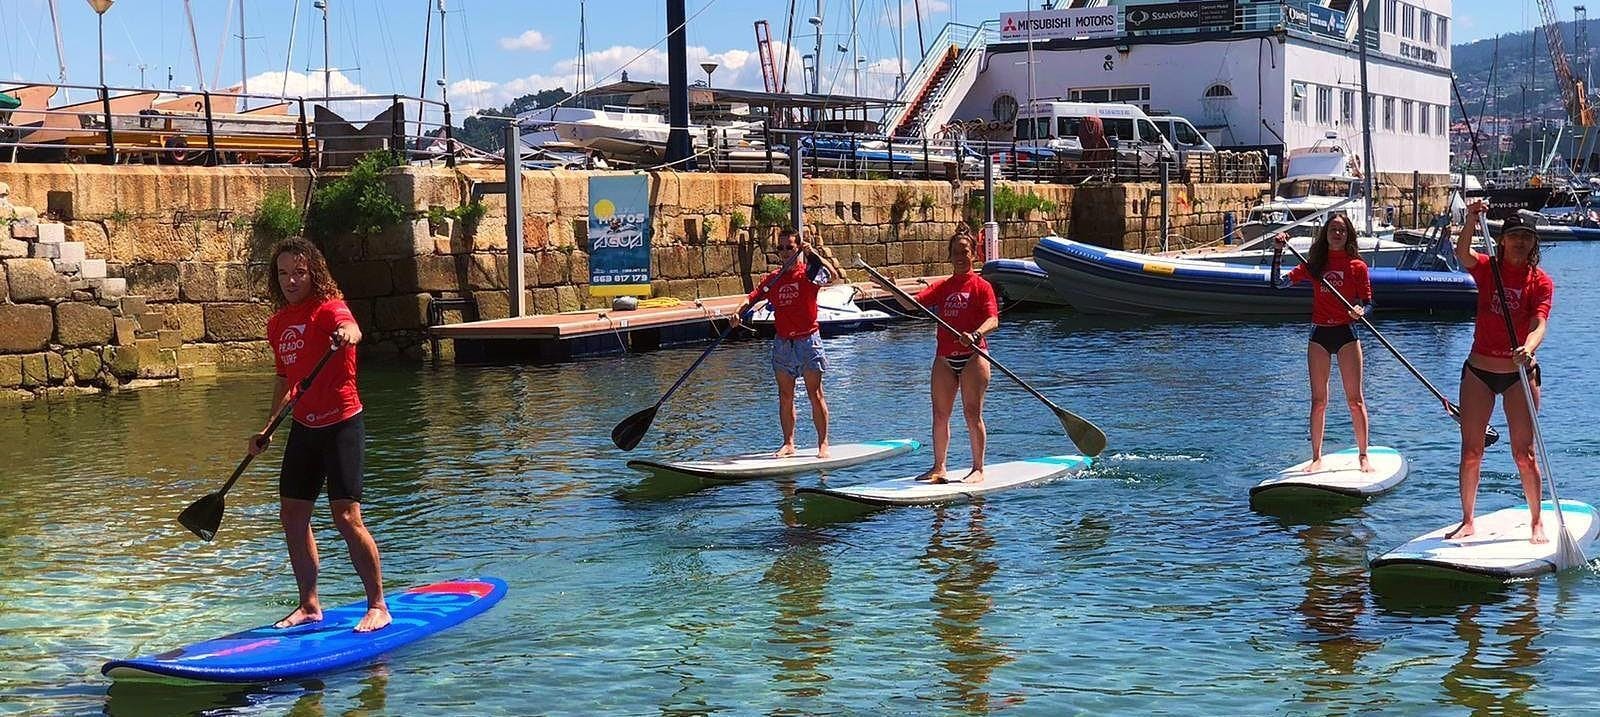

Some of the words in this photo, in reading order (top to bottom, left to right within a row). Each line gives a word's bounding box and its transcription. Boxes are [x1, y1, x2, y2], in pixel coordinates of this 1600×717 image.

[1018, 17, 1071, 31] MITSUBISHI
[1075, 15, 1115, 27] MOTORS
[598, 213, 645, 225] MOTOS
[593, 232, 643, 251] AGUA
[779, 292, 799, 300] PRADO
[279, 339, 304, 353] PRADO
